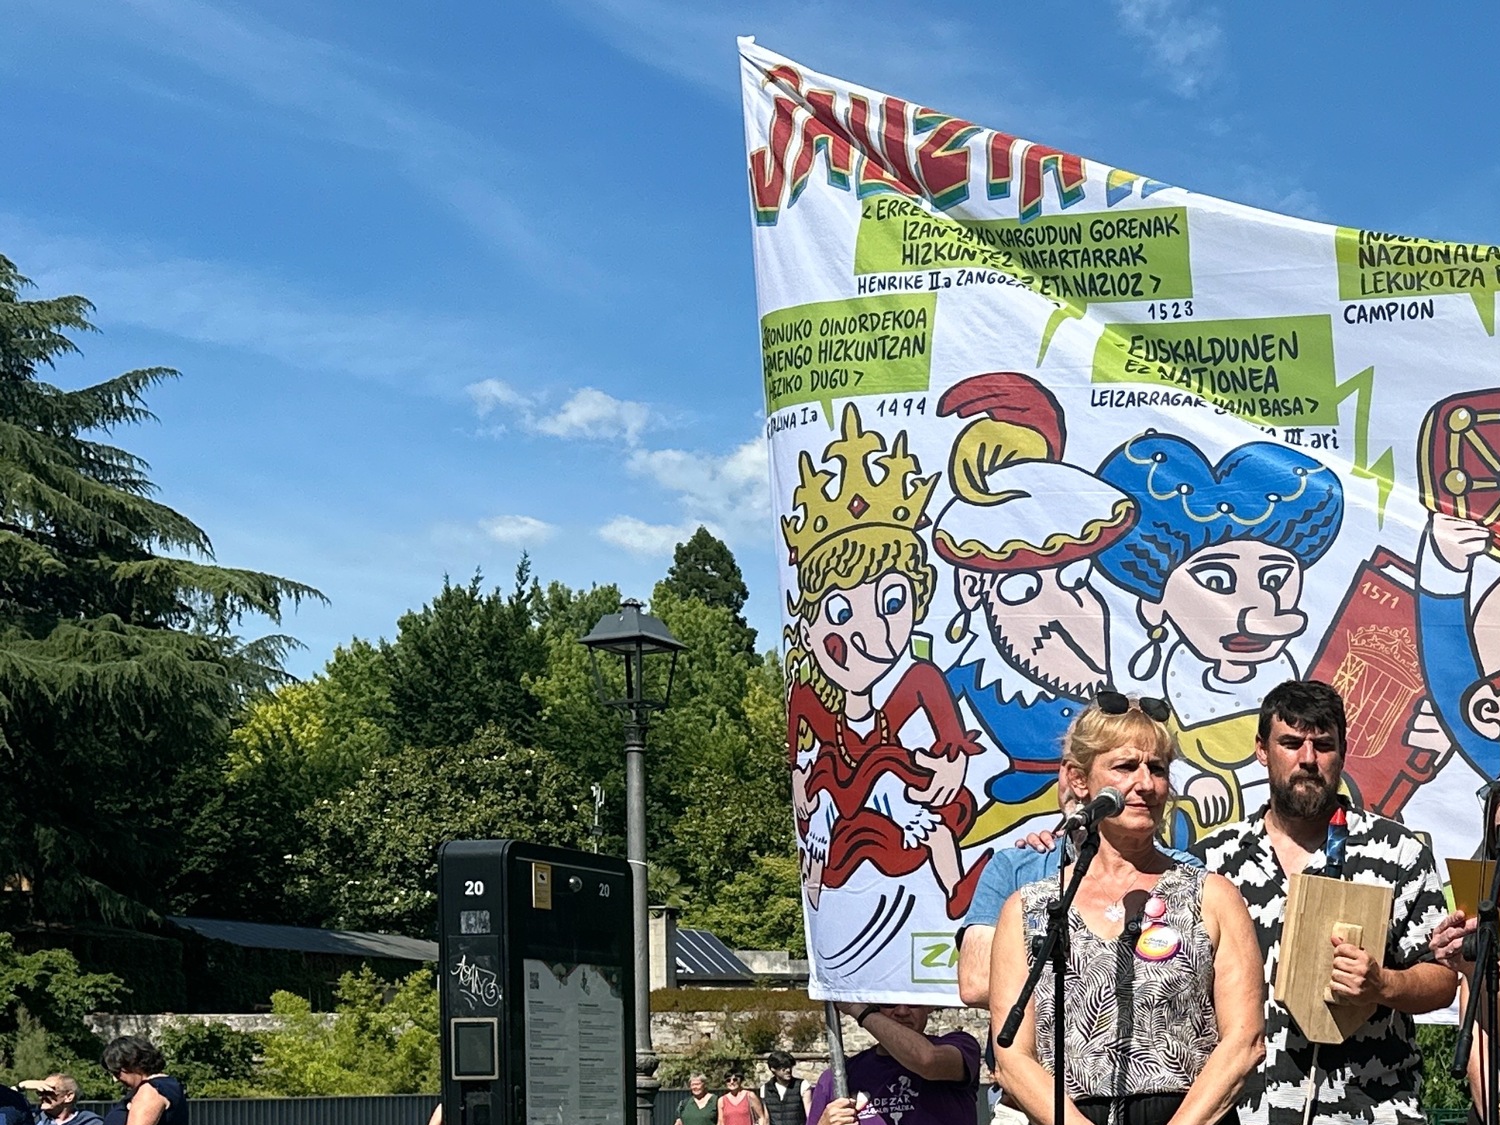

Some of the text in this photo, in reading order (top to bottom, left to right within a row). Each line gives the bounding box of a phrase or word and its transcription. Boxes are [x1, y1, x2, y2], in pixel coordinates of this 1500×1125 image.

[1089, 213, 1181, 241] GORENAK
[1019, 242, 1148, 271] NAFARTARRAK
[857, 270, 924, 295] HENRIKE
[1360, 266, 1486, 296] LEKUKOTZA
[819, 307, 927, 337] OINORDEKOA
[1147, 300, 1194, 320] 1523
[1343, 299, 1435, 325] CAMPION
[817, 332, 927, 364] HIZKUNTZAN
[1127, 331, 1299, 367] EUSKALDUNEN
[810, 368, 849, 392] DUGU
[876, 396, 927, 417] 1494
[1361, 581, 1400, 610] 1571
[464, 880, 485, 896] 20
[598, 876, 611, 898] 20
